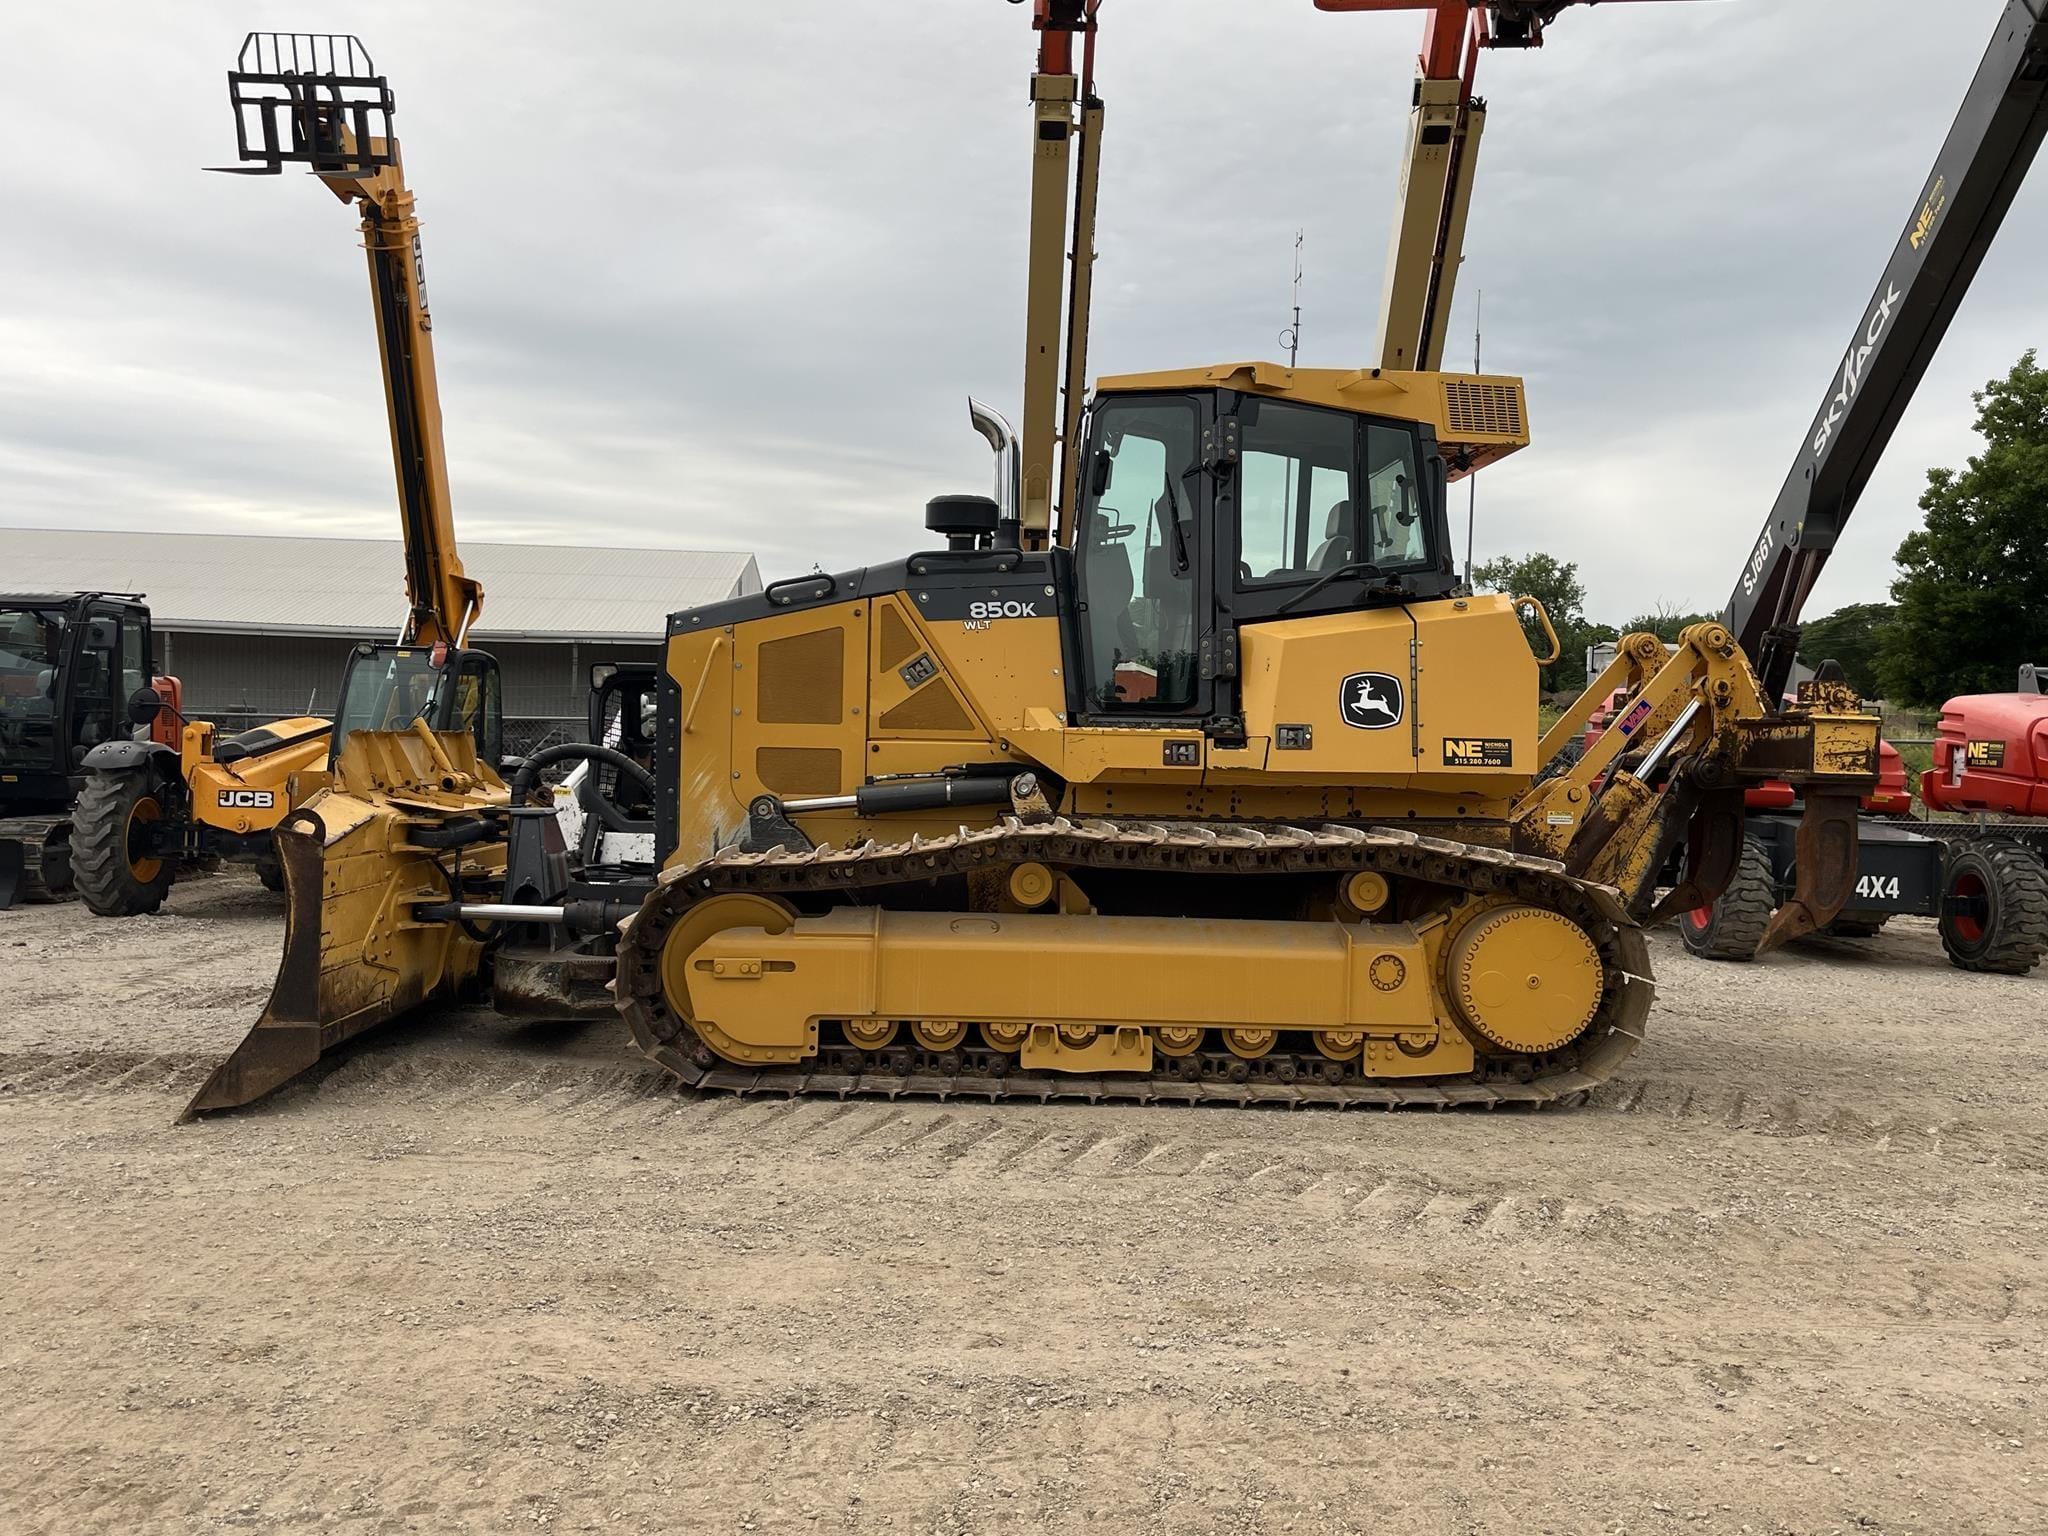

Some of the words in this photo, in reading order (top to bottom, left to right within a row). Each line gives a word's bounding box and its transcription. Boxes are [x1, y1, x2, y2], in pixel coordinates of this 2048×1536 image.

[1910, 201, 1933, 250] NE
[1813, 280, 1901, 457] SKYJACK
[1743, 524, 1774, 596] SJ66T
[969, 600, 1037, 619] 850K
[963, 620, 991, 630] WLT
[1445, 740, 1483, 757] NE
[1968, 742, 1989, 758] NE
[219, 791, 273, 807] JCB
[1855, 875, 1900, 899] 4X4
